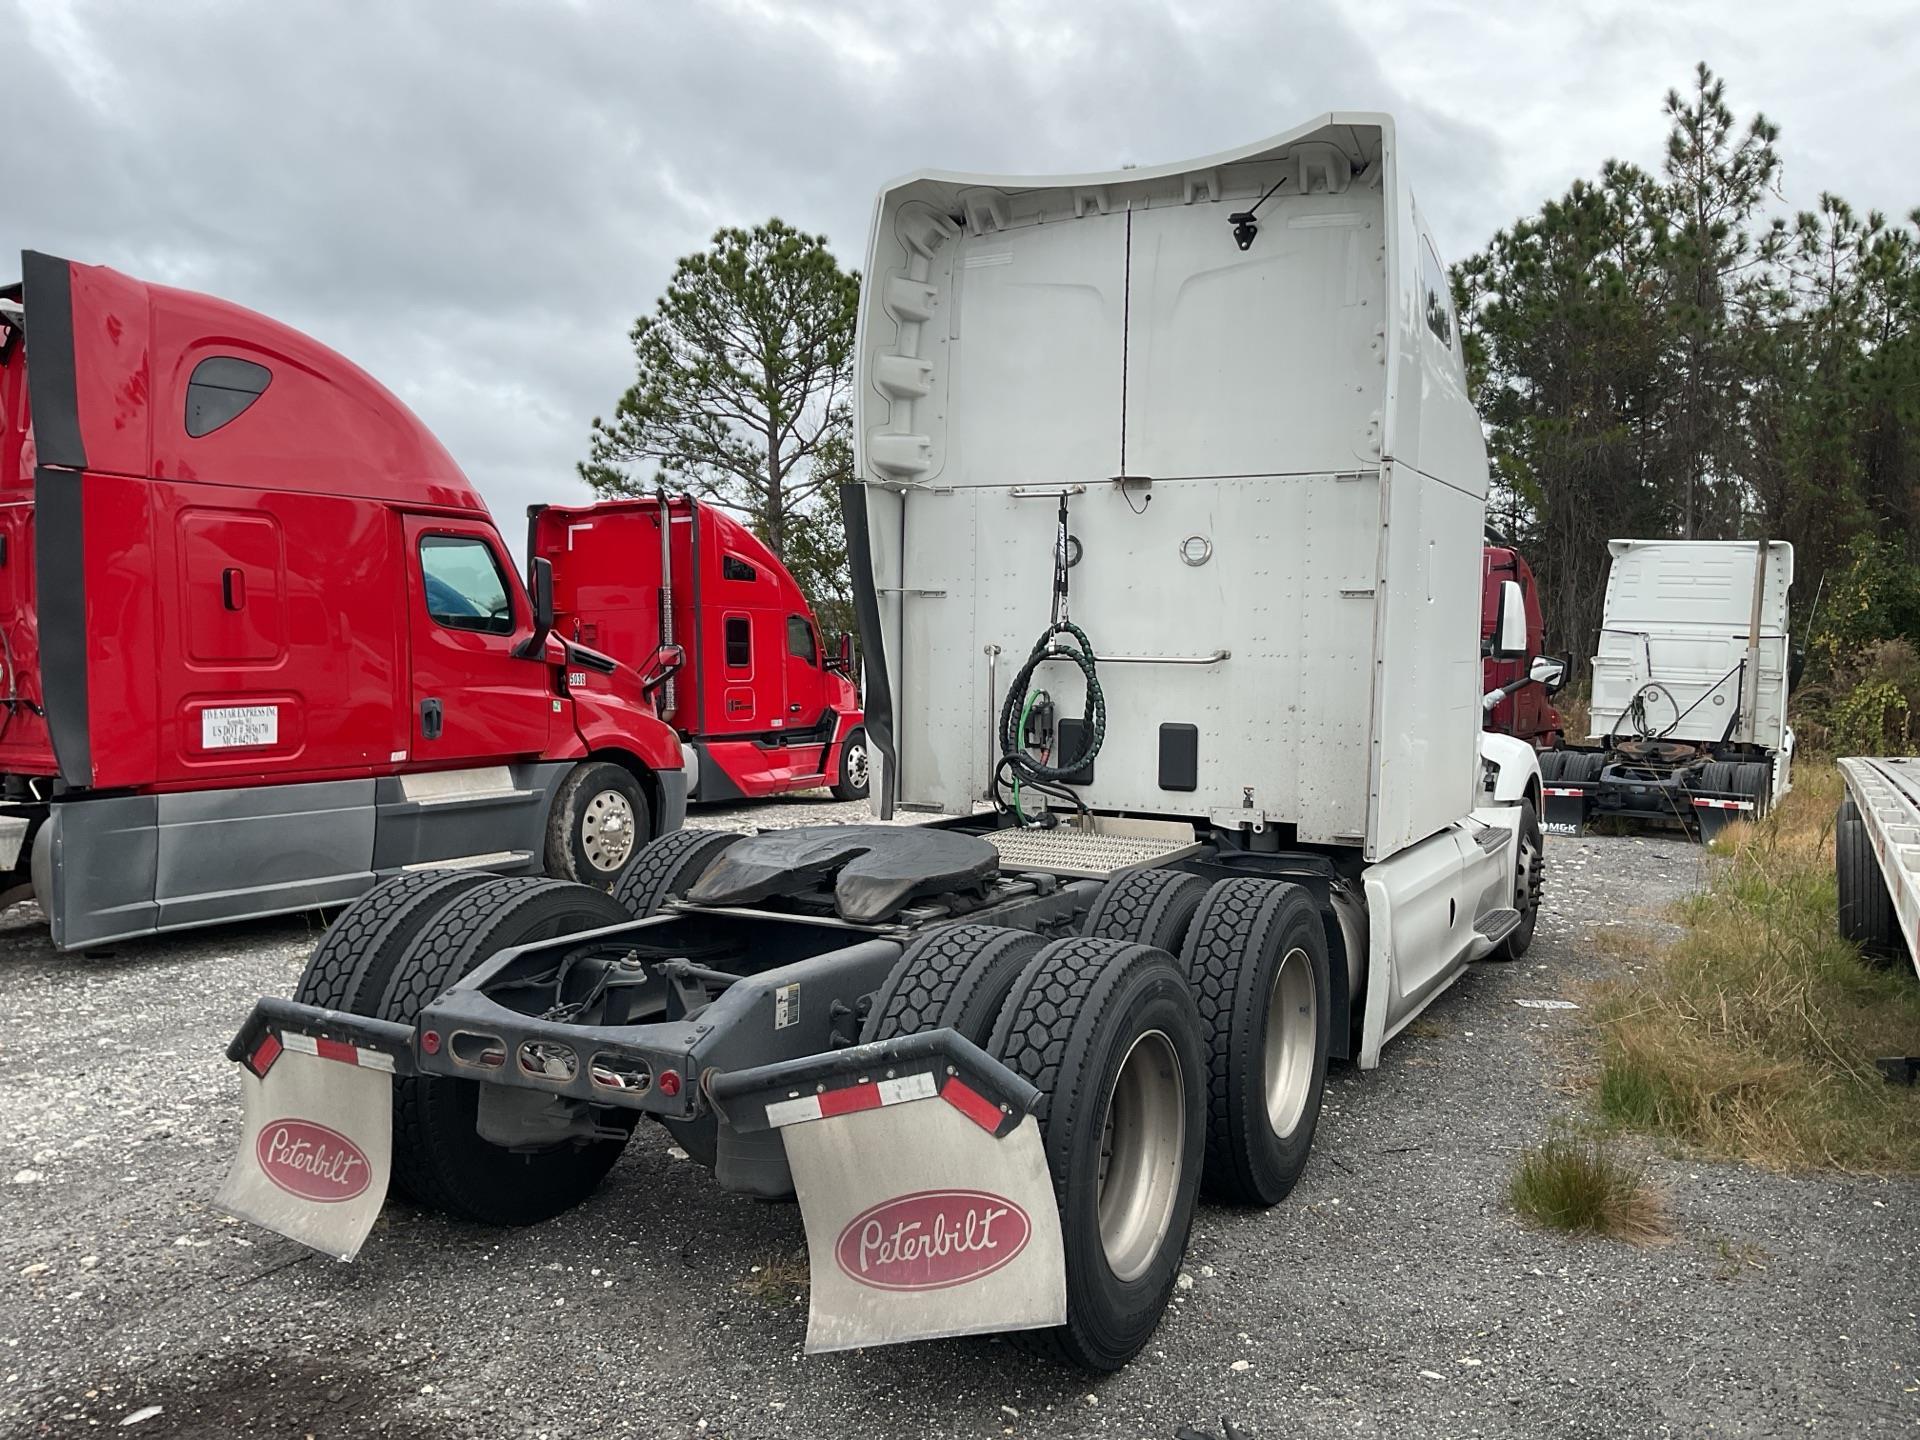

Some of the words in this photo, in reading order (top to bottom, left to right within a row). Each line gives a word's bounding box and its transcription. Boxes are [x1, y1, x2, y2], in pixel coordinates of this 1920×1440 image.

[204, 709, 218, 719] FIVE
[219, 708, 236, 718] STAR
[237, 707, 265, 718] EXPRESS
[223, 724, 238, 736] DOT
[268, 1128, 361, 1184] Peterbilt
[860, 1208, 1007, 1272] Peterbilt
